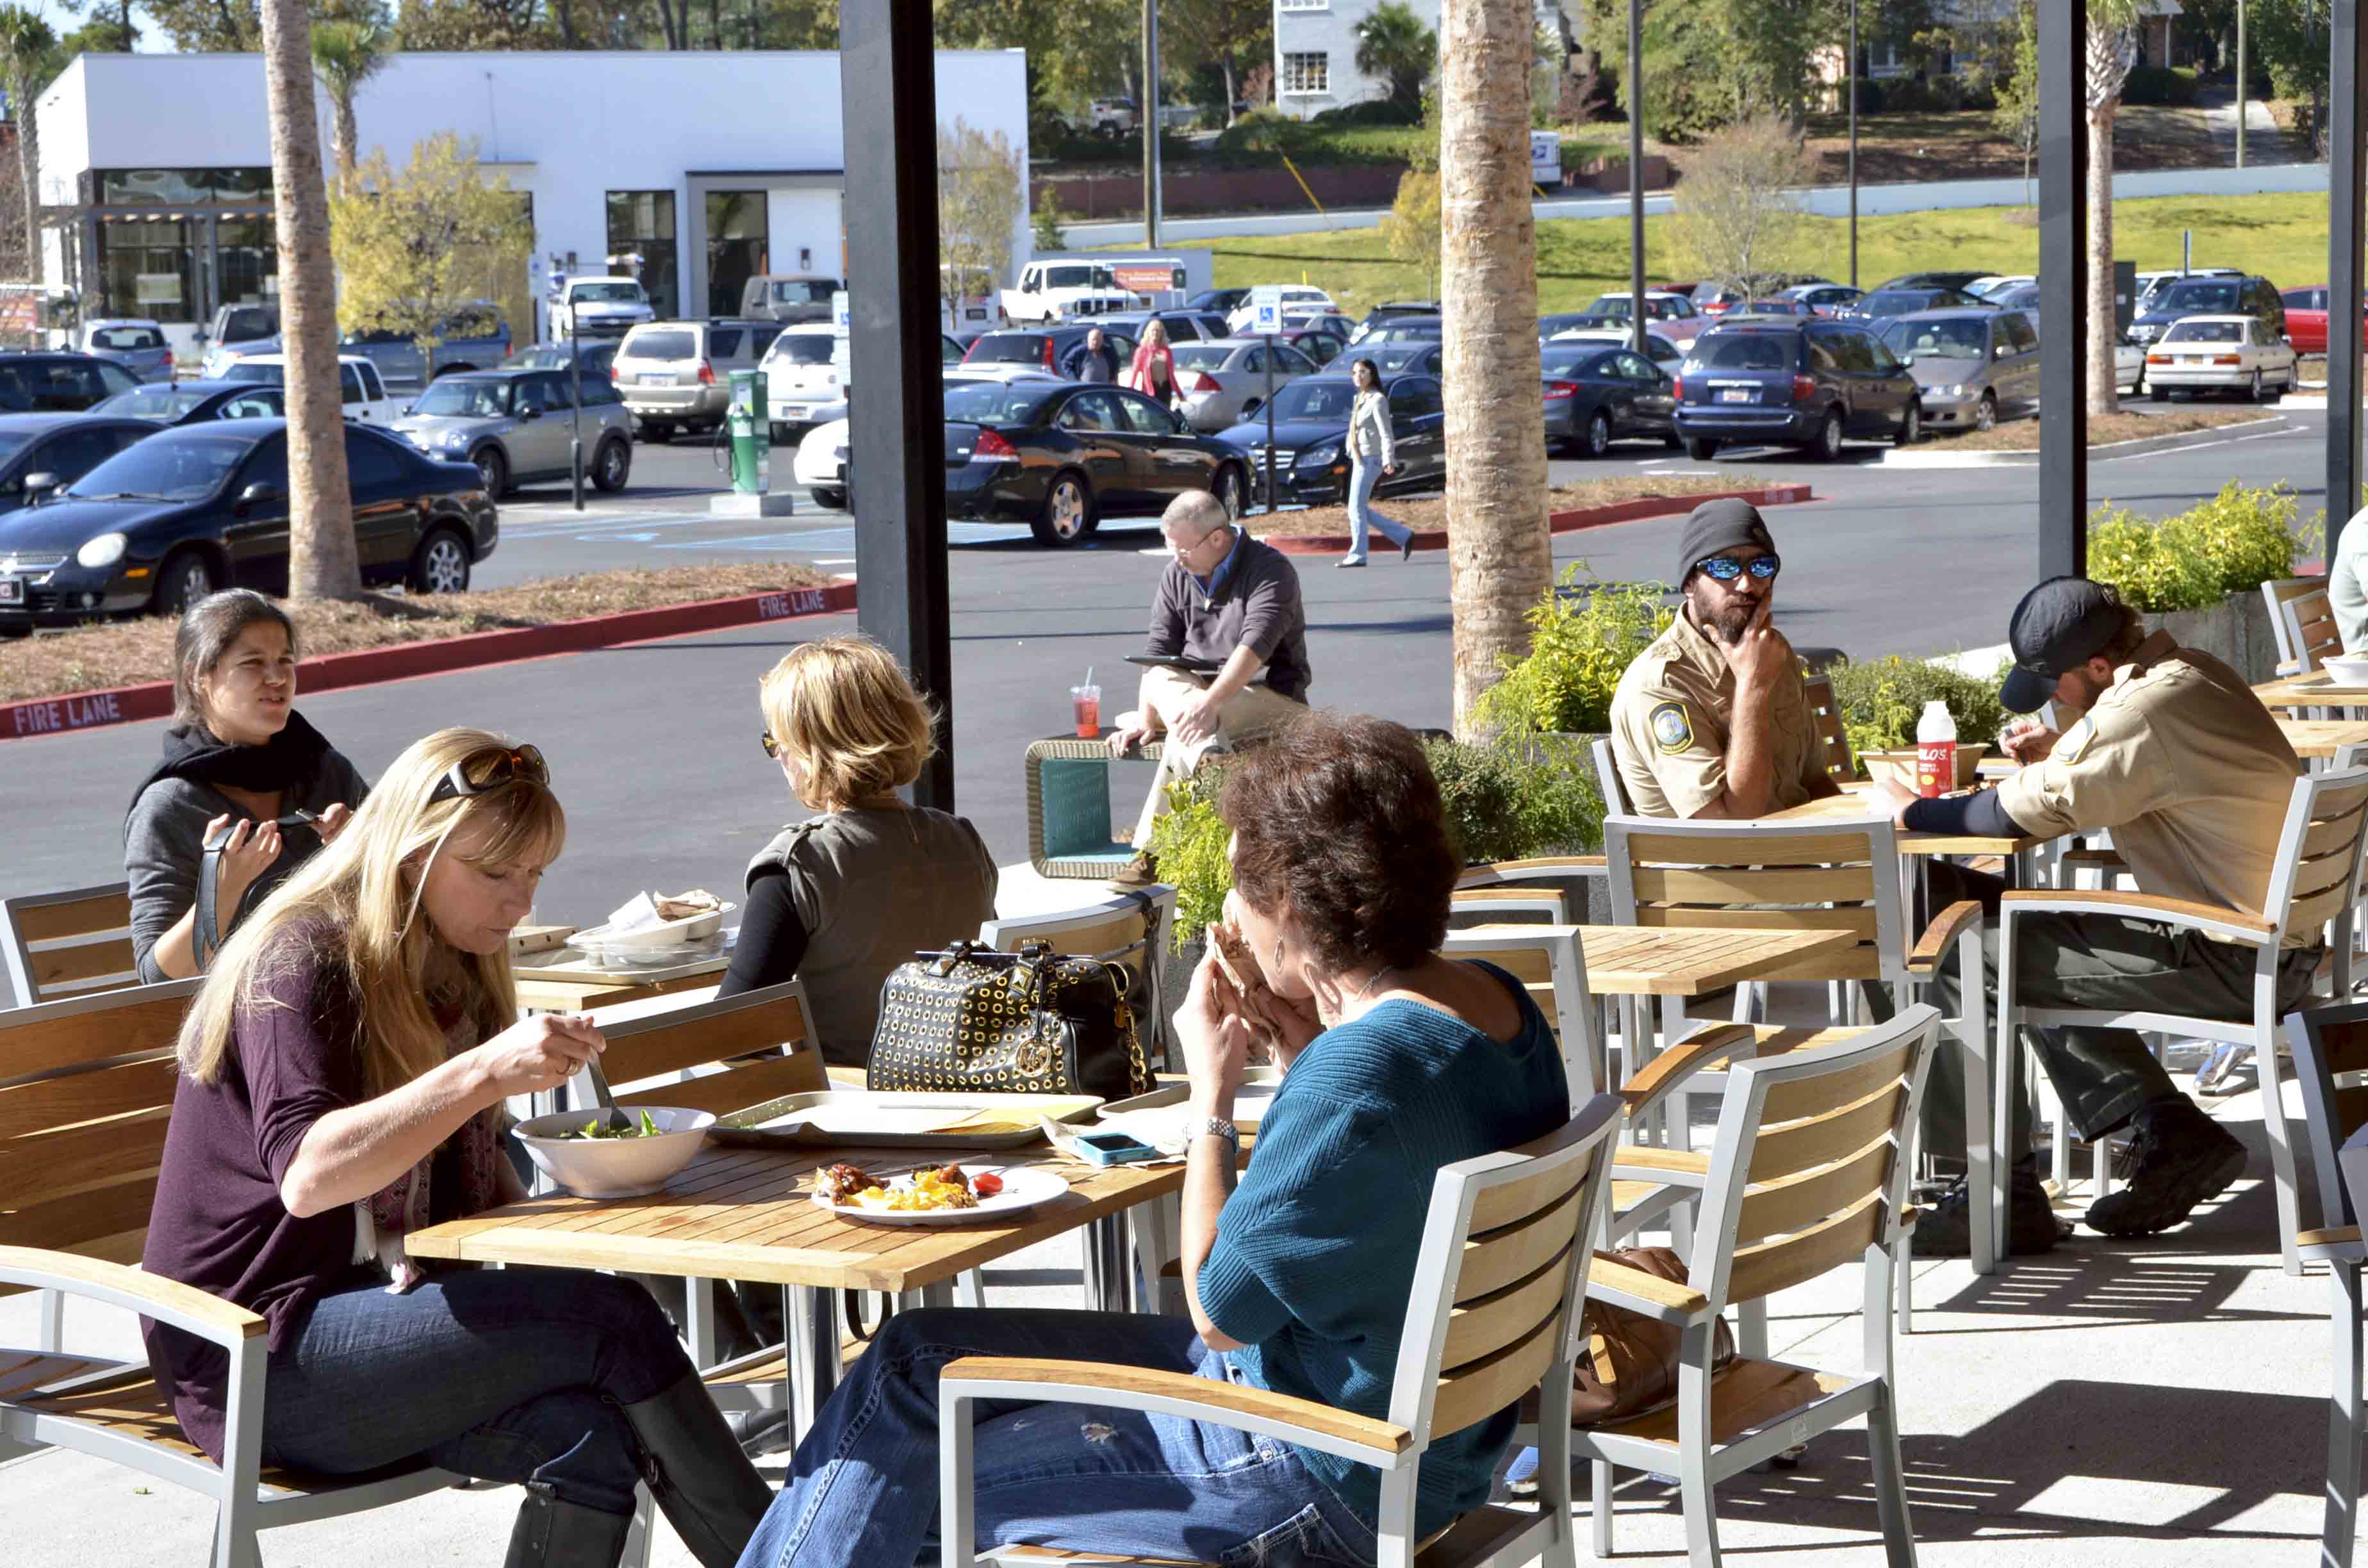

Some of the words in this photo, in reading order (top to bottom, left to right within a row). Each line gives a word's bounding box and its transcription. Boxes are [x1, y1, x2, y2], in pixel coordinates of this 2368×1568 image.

[759, 594, 789, 619] FIRE
[791, 590, 825, 613] LANE
[13, 703, 62, 734] FIRE
[66, 694, 121, 726] LANE
